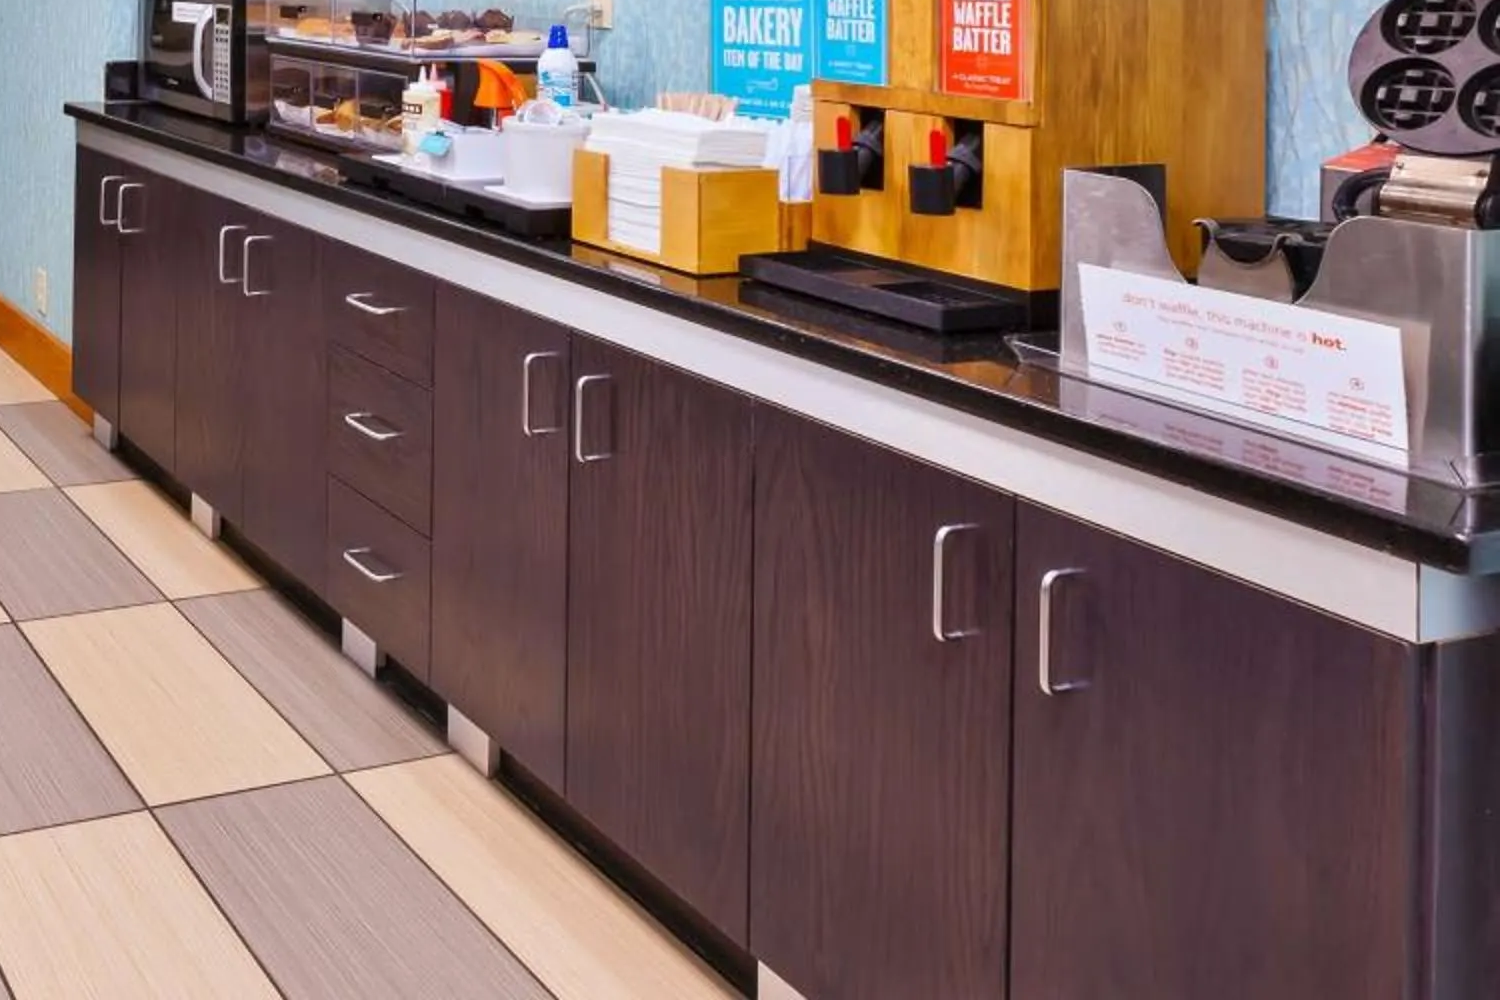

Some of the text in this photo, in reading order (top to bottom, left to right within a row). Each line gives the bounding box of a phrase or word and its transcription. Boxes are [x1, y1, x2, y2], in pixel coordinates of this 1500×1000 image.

[723, 5, 803, 47] BAKERY
[952, 0, 1012, 28] WAFFLE
[826, 17, 875, 43] BATTER
[952, 26, 1012, 55] BATTER
[723, 49, 803, 73] ITEM OF THE DAY
[1310, 331, 1348, 352] hot.
